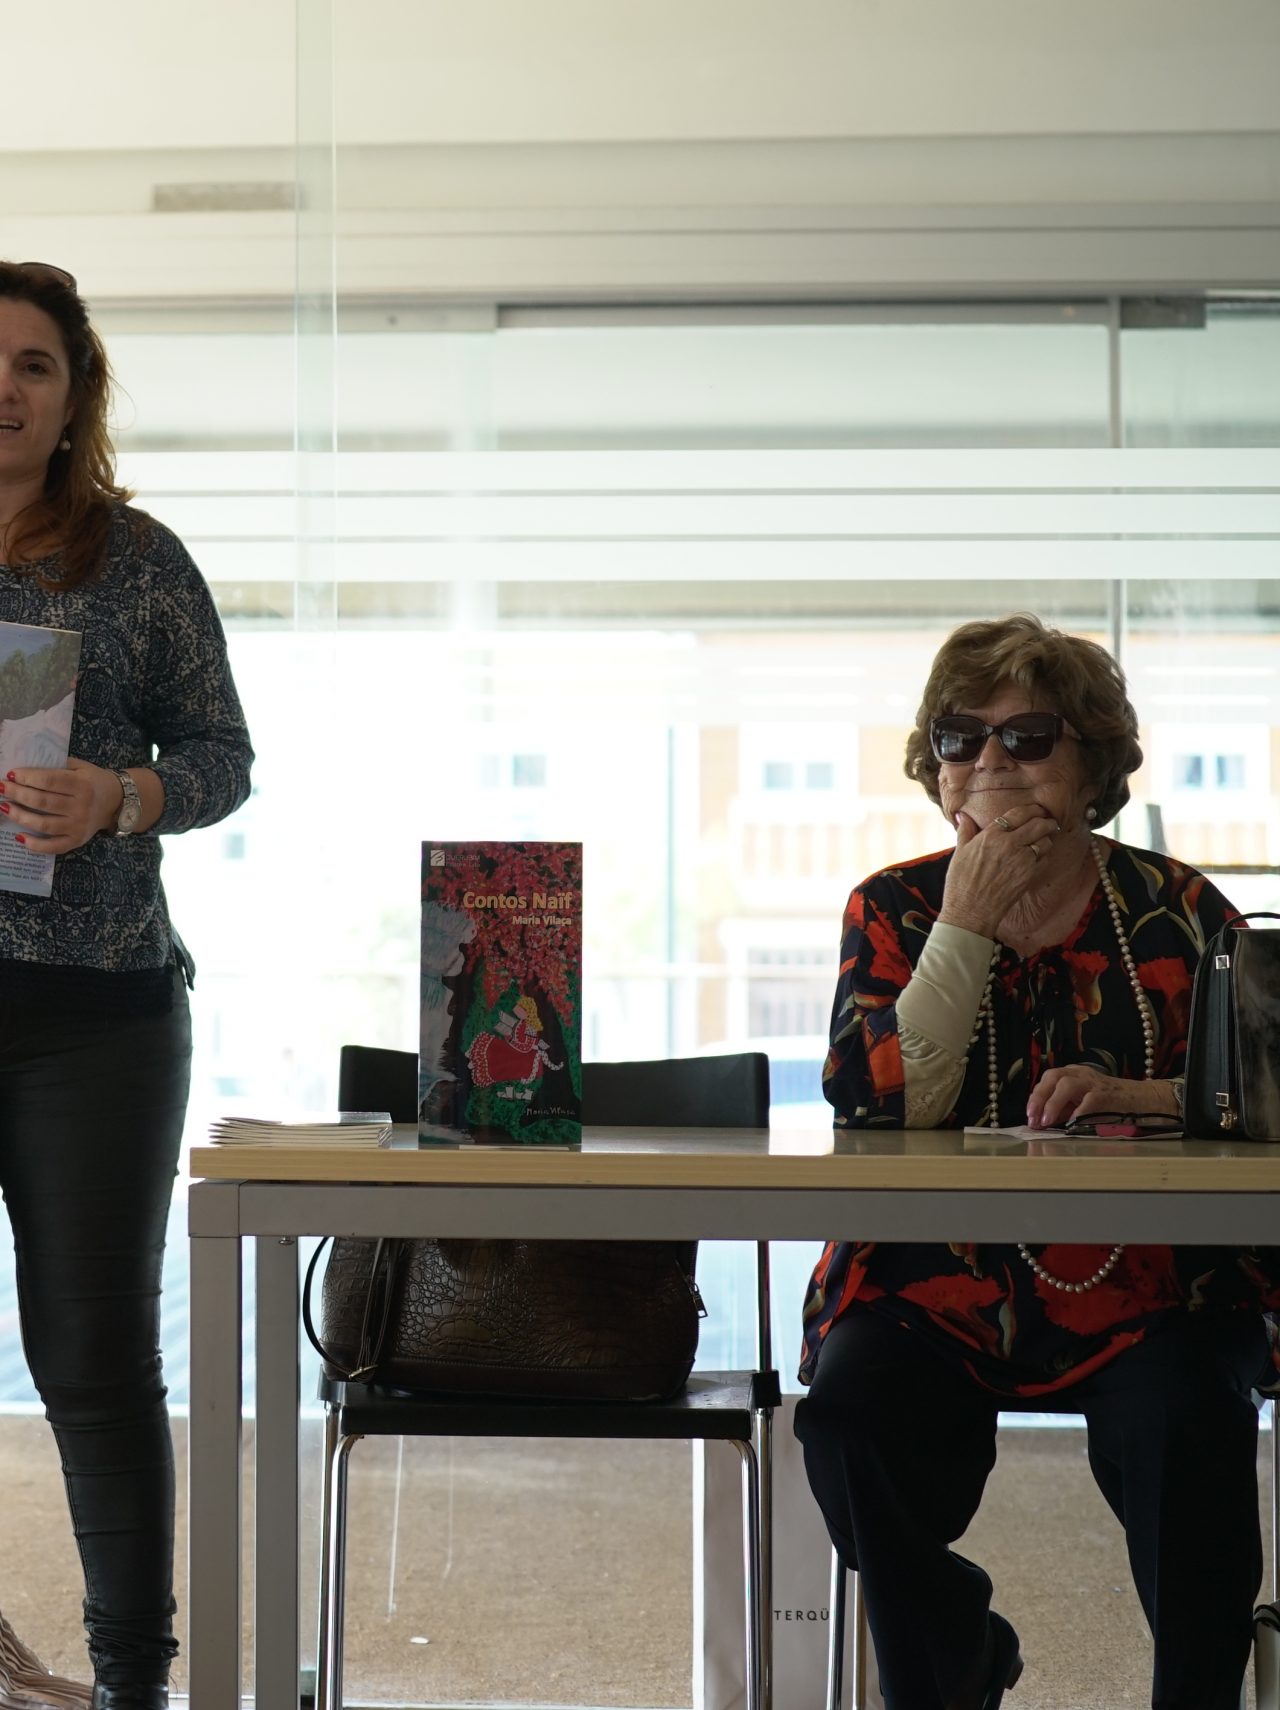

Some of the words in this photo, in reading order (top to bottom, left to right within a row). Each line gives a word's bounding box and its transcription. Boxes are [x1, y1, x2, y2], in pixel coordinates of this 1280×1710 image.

[463, 891, 527, 909] Contos
[532, 891, 573, 909] Naïf
[512, 915, 541, 925] Maria
[543, 915, 572, 927] Vilaça
[773, 1607, 830, 1621] TERQÜ
